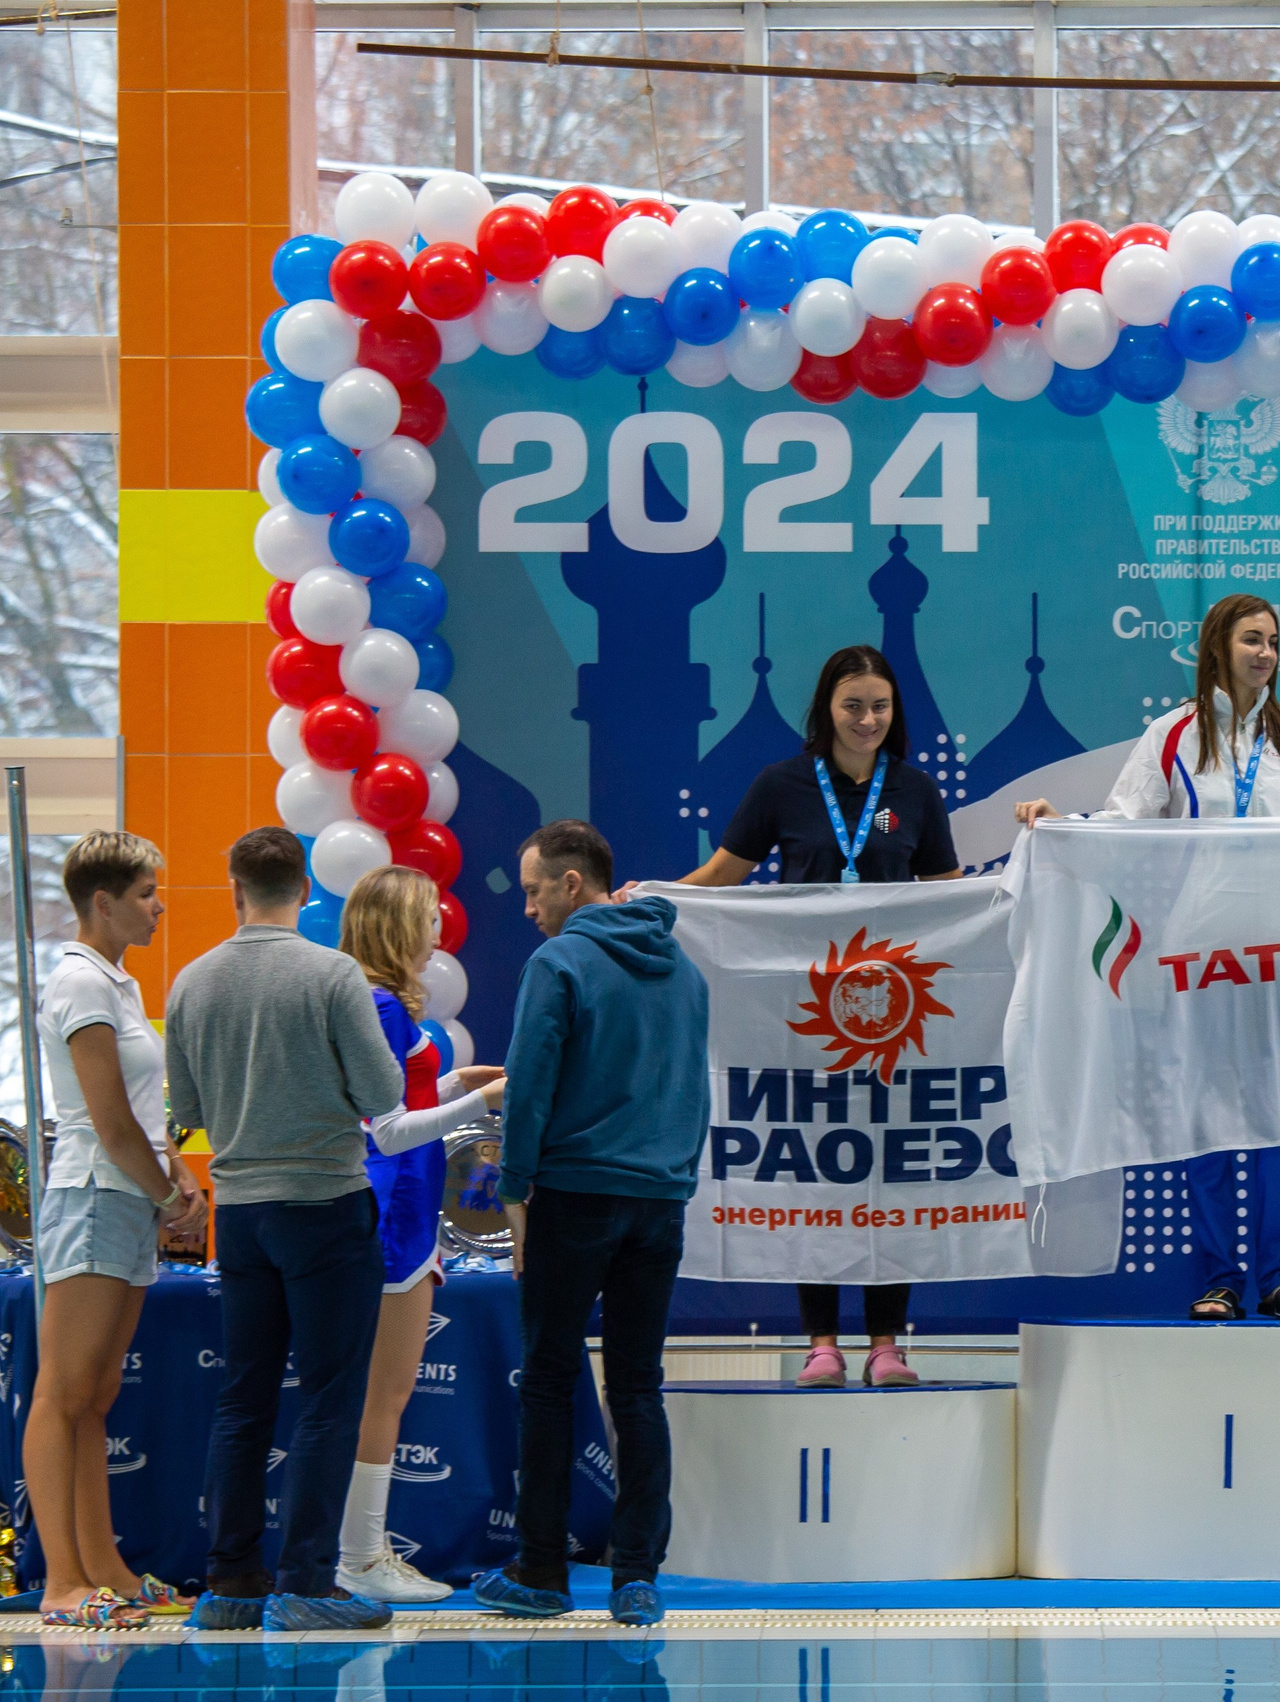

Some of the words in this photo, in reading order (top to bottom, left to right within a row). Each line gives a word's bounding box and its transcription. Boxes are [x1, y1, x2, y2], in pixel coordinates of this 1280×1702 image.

[477, 411, 990, 553] 2024
[1154, 515, 1186, 531] ПРИ
[1117, 561, 1226, 579] РОССИЙСКОЙ
[727, 1065, 1008, 1124] ИНТЕР
[712, 1205, 843, 1231] энергия
[851, 1203, 906, 1228] без
[914, 1201, 1027, 1230] границ
